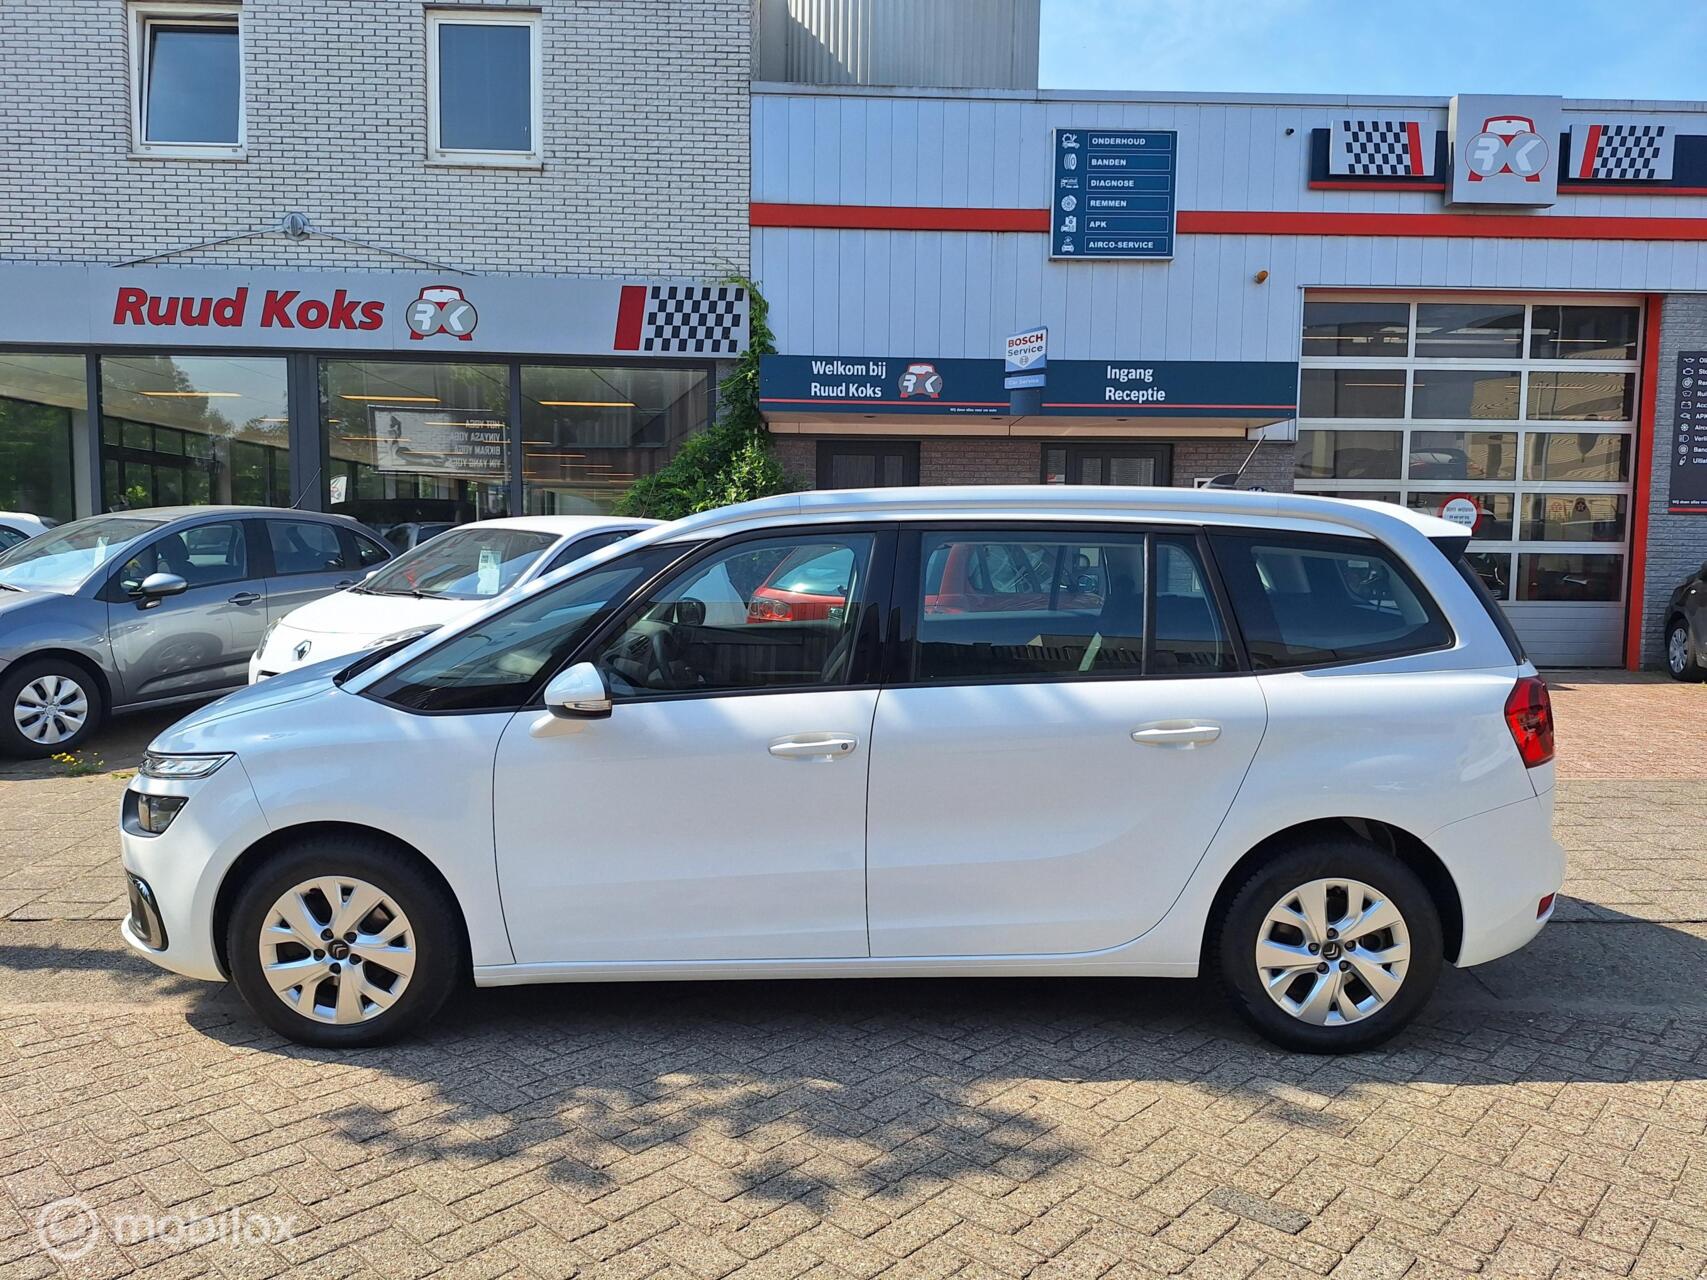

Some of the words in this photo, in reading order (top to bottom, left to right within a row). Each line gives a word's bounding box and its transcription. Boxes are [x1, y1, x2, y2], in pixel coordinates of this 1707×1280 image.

[1092, 137, 1146, 145] ONDERHOUD
[1091, 158, 1126, 166] BANDEN
[1090, 179, 1134, 187] DIAGNOSE
[1090, 199, 1127, 207] REMMEN
[1088, 241, 1154, 249] AIRCO-SERVICE
[113, 287, 249, 327] Ruud
[260, 289, 385, 331] Koks
[1008, 333, 1044, 348] BOSCH
[1008, 345, 1044, 357] Service
[812, 361, 866, 375] Welkom
[869, 361, 887, 379] bij
[1107, 365, 1154, 382] Ingang
[810, 382, 846, 397] Ruud
[849, 383, 882, 398] Koks
[1105, 387, 1166, 404] Receptie
